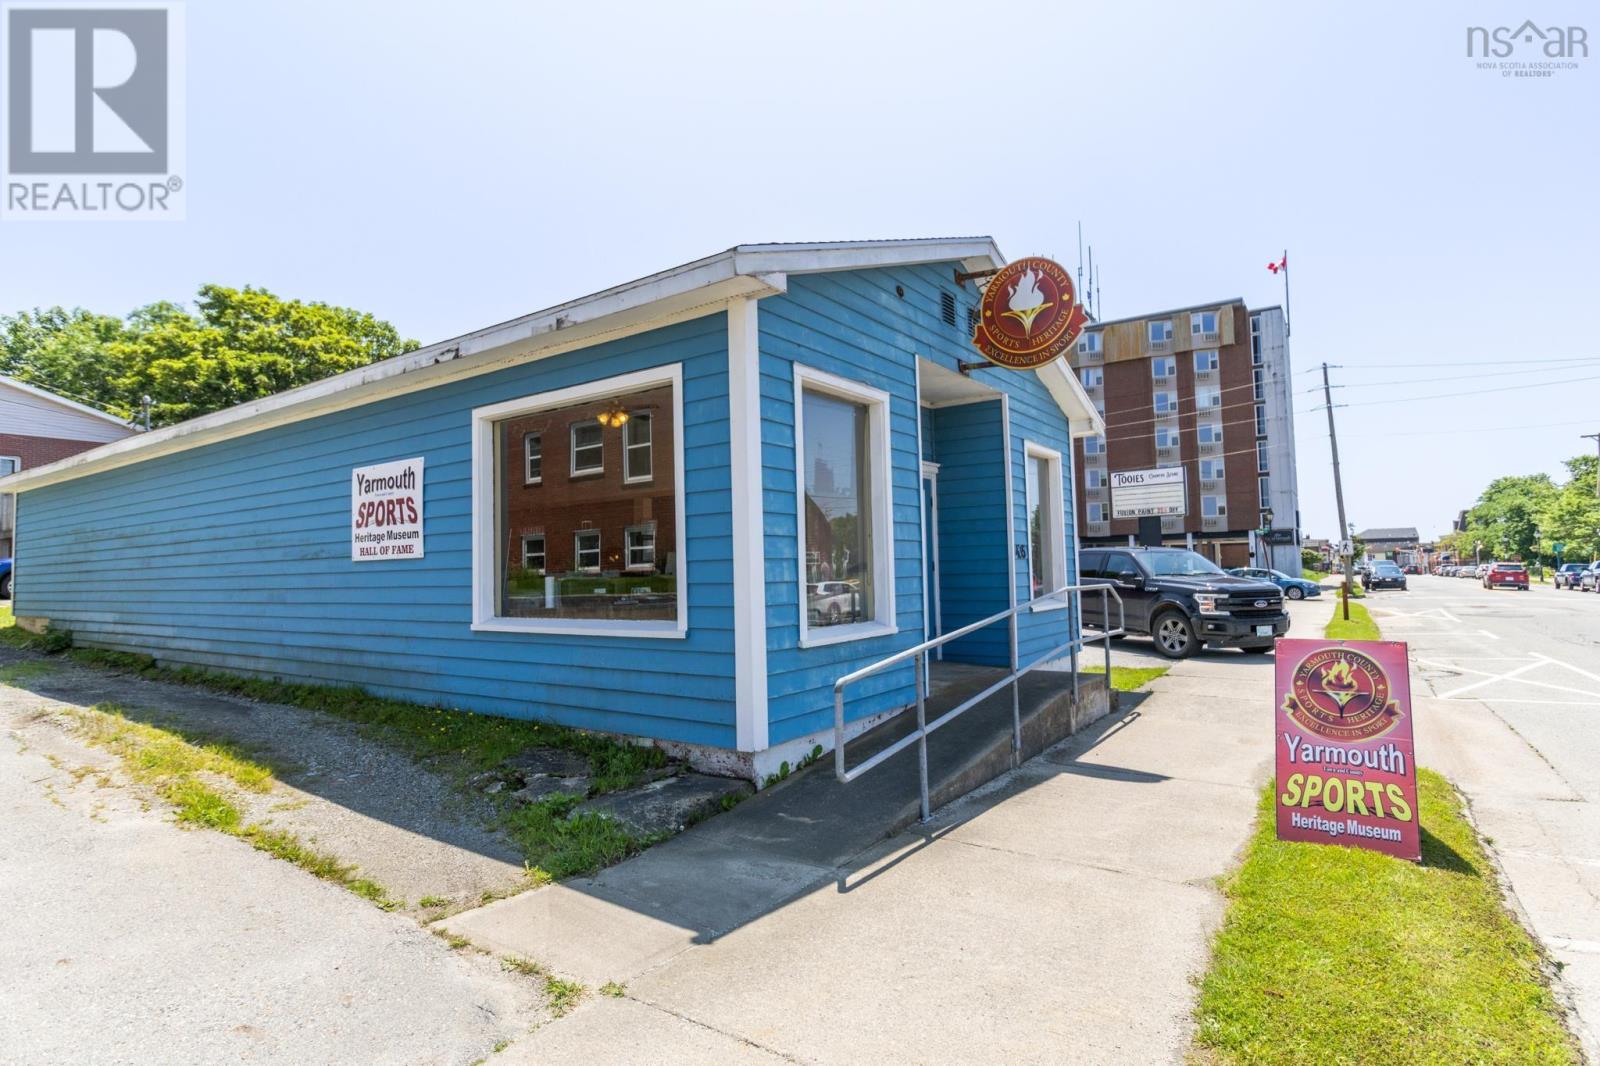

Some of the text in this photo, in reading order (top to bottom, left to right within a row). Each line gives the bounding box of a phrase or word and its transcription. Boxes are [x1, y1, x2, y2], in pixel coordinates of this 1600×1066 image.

[986, 260, 1069, 303] YARMOUTH COUNTY
[990, 309, 1069, 349] SPORTS HERITAGE
[985, 329, 1075, 364] EXCELLENCE IN SPORT
[356, 465, 416, 497] Yarmouth
[355, 496, 418, 529] SPORTS
[354, 530, 419, 545] Heritage Museum
[359, 544, 415, 557] HALL OF FAME
[1300, 651, 1381, 681] YARMOUTH COUNTY
[1298, 688, 1385, 724] SPORTS HERITAGE
[1295, 711, 1388, 737] EXCELLENCE IN SPORT
[1284, 732, 1406, 775] Yarmouth
[1281, 773, 1412, 822] SPORTS
[1291, 812, 1402, 842] Heritage Museum
